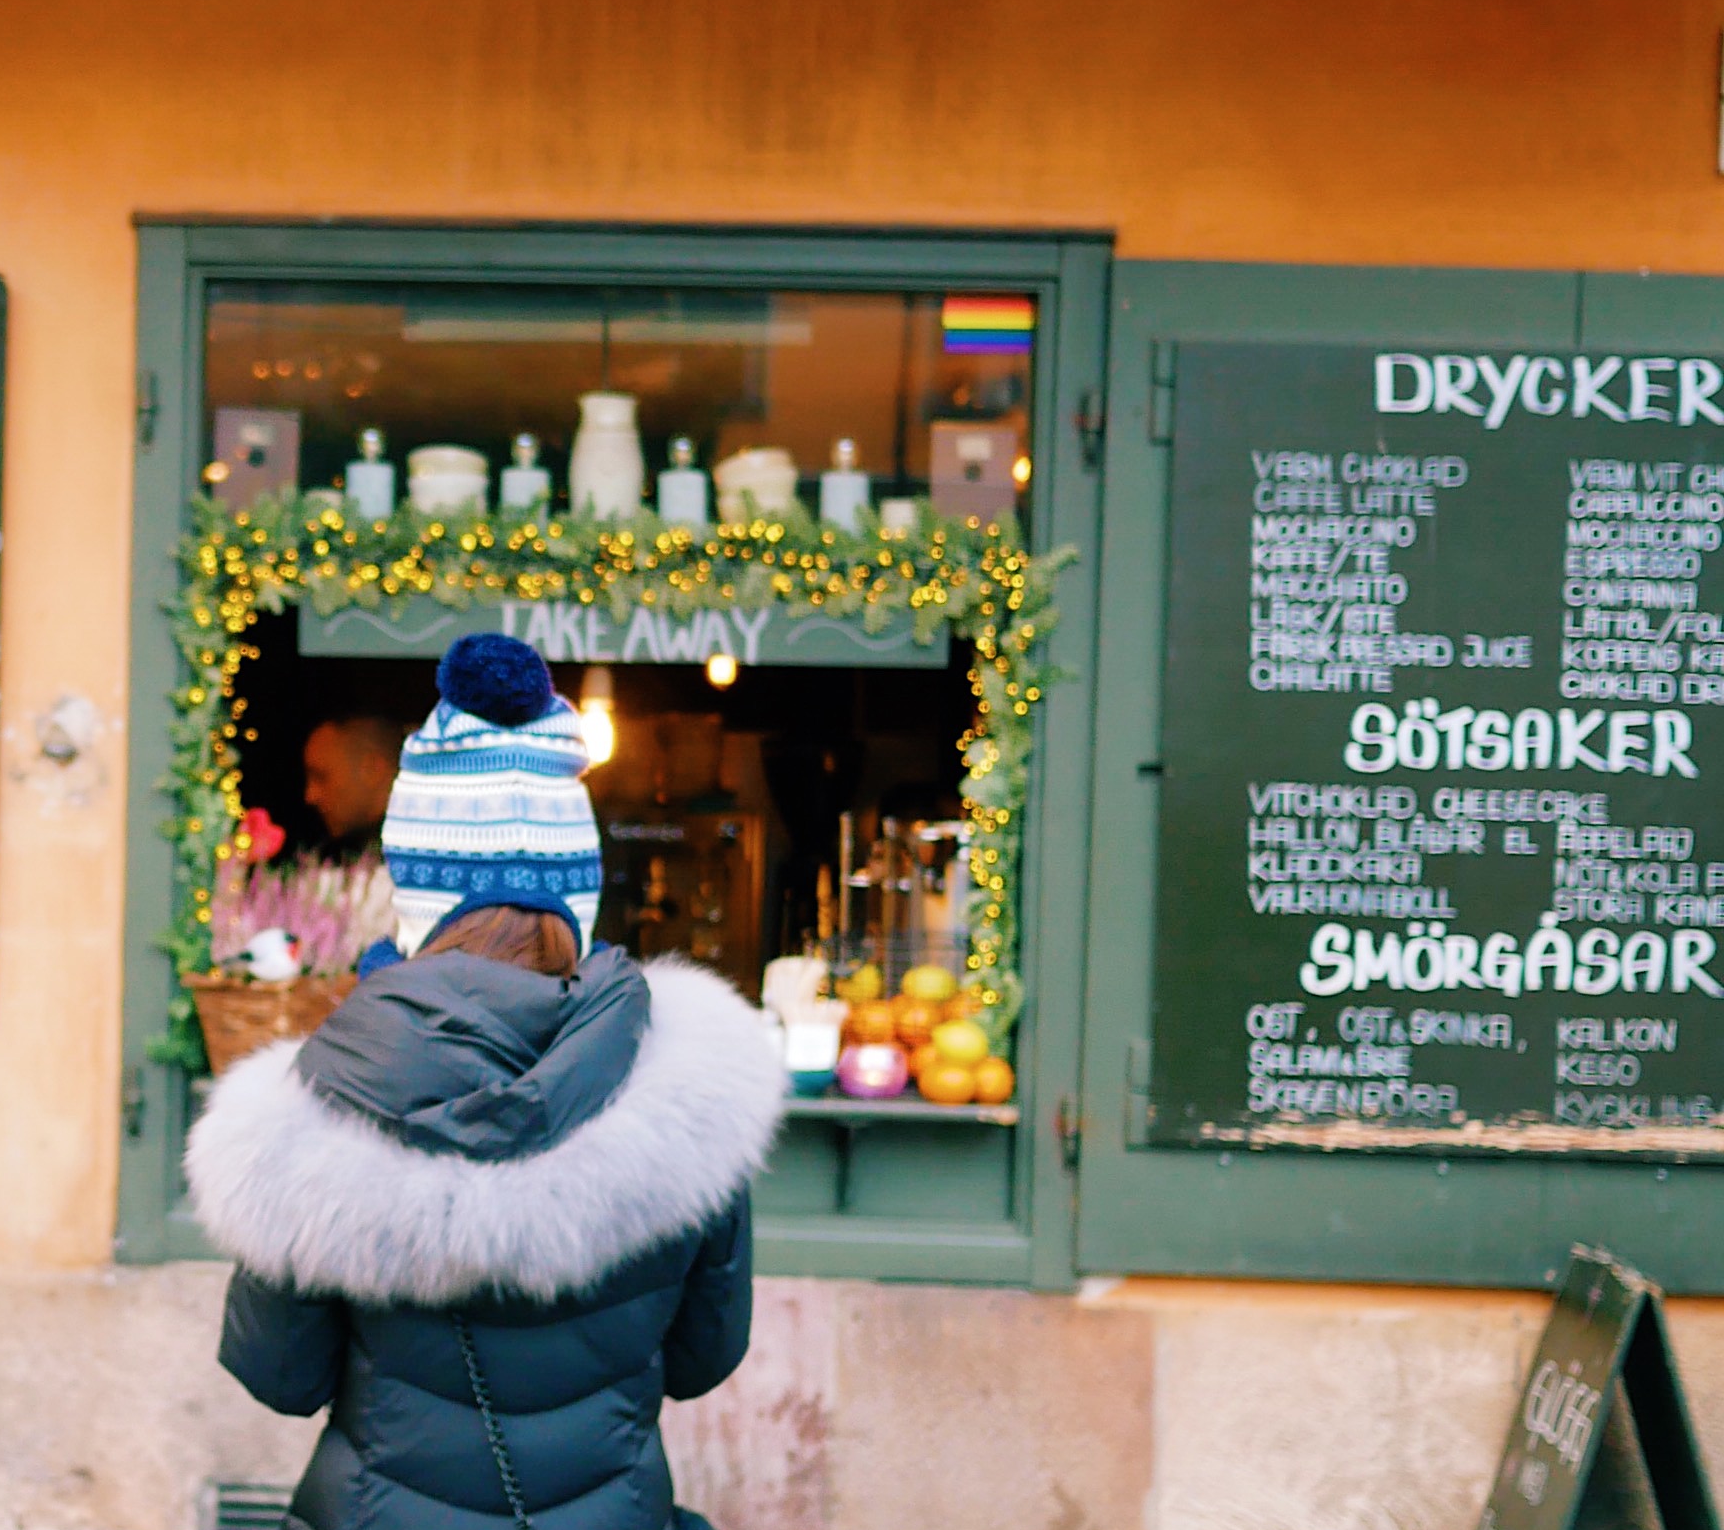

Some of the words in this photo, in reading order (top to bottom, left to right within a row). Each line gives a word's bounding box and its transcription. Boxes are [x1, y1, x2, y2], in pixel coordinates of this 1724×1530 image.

[1375, 352, 1724, 431] DRYCKER
[1351, 485, 1436, 516] LATTE
[1565, 548, 1702, 579] ESPRESSO
[1462, 634, 1533, 668] JUICE
[1343, 697, 1700, 780] SÖTSAKER
[1299, 911, 1724, 999] SMÖRGÅSAR
[1556, 1017, 1678, 1052] KALKON
[1555, 1052, 1642, 1087] KESO
